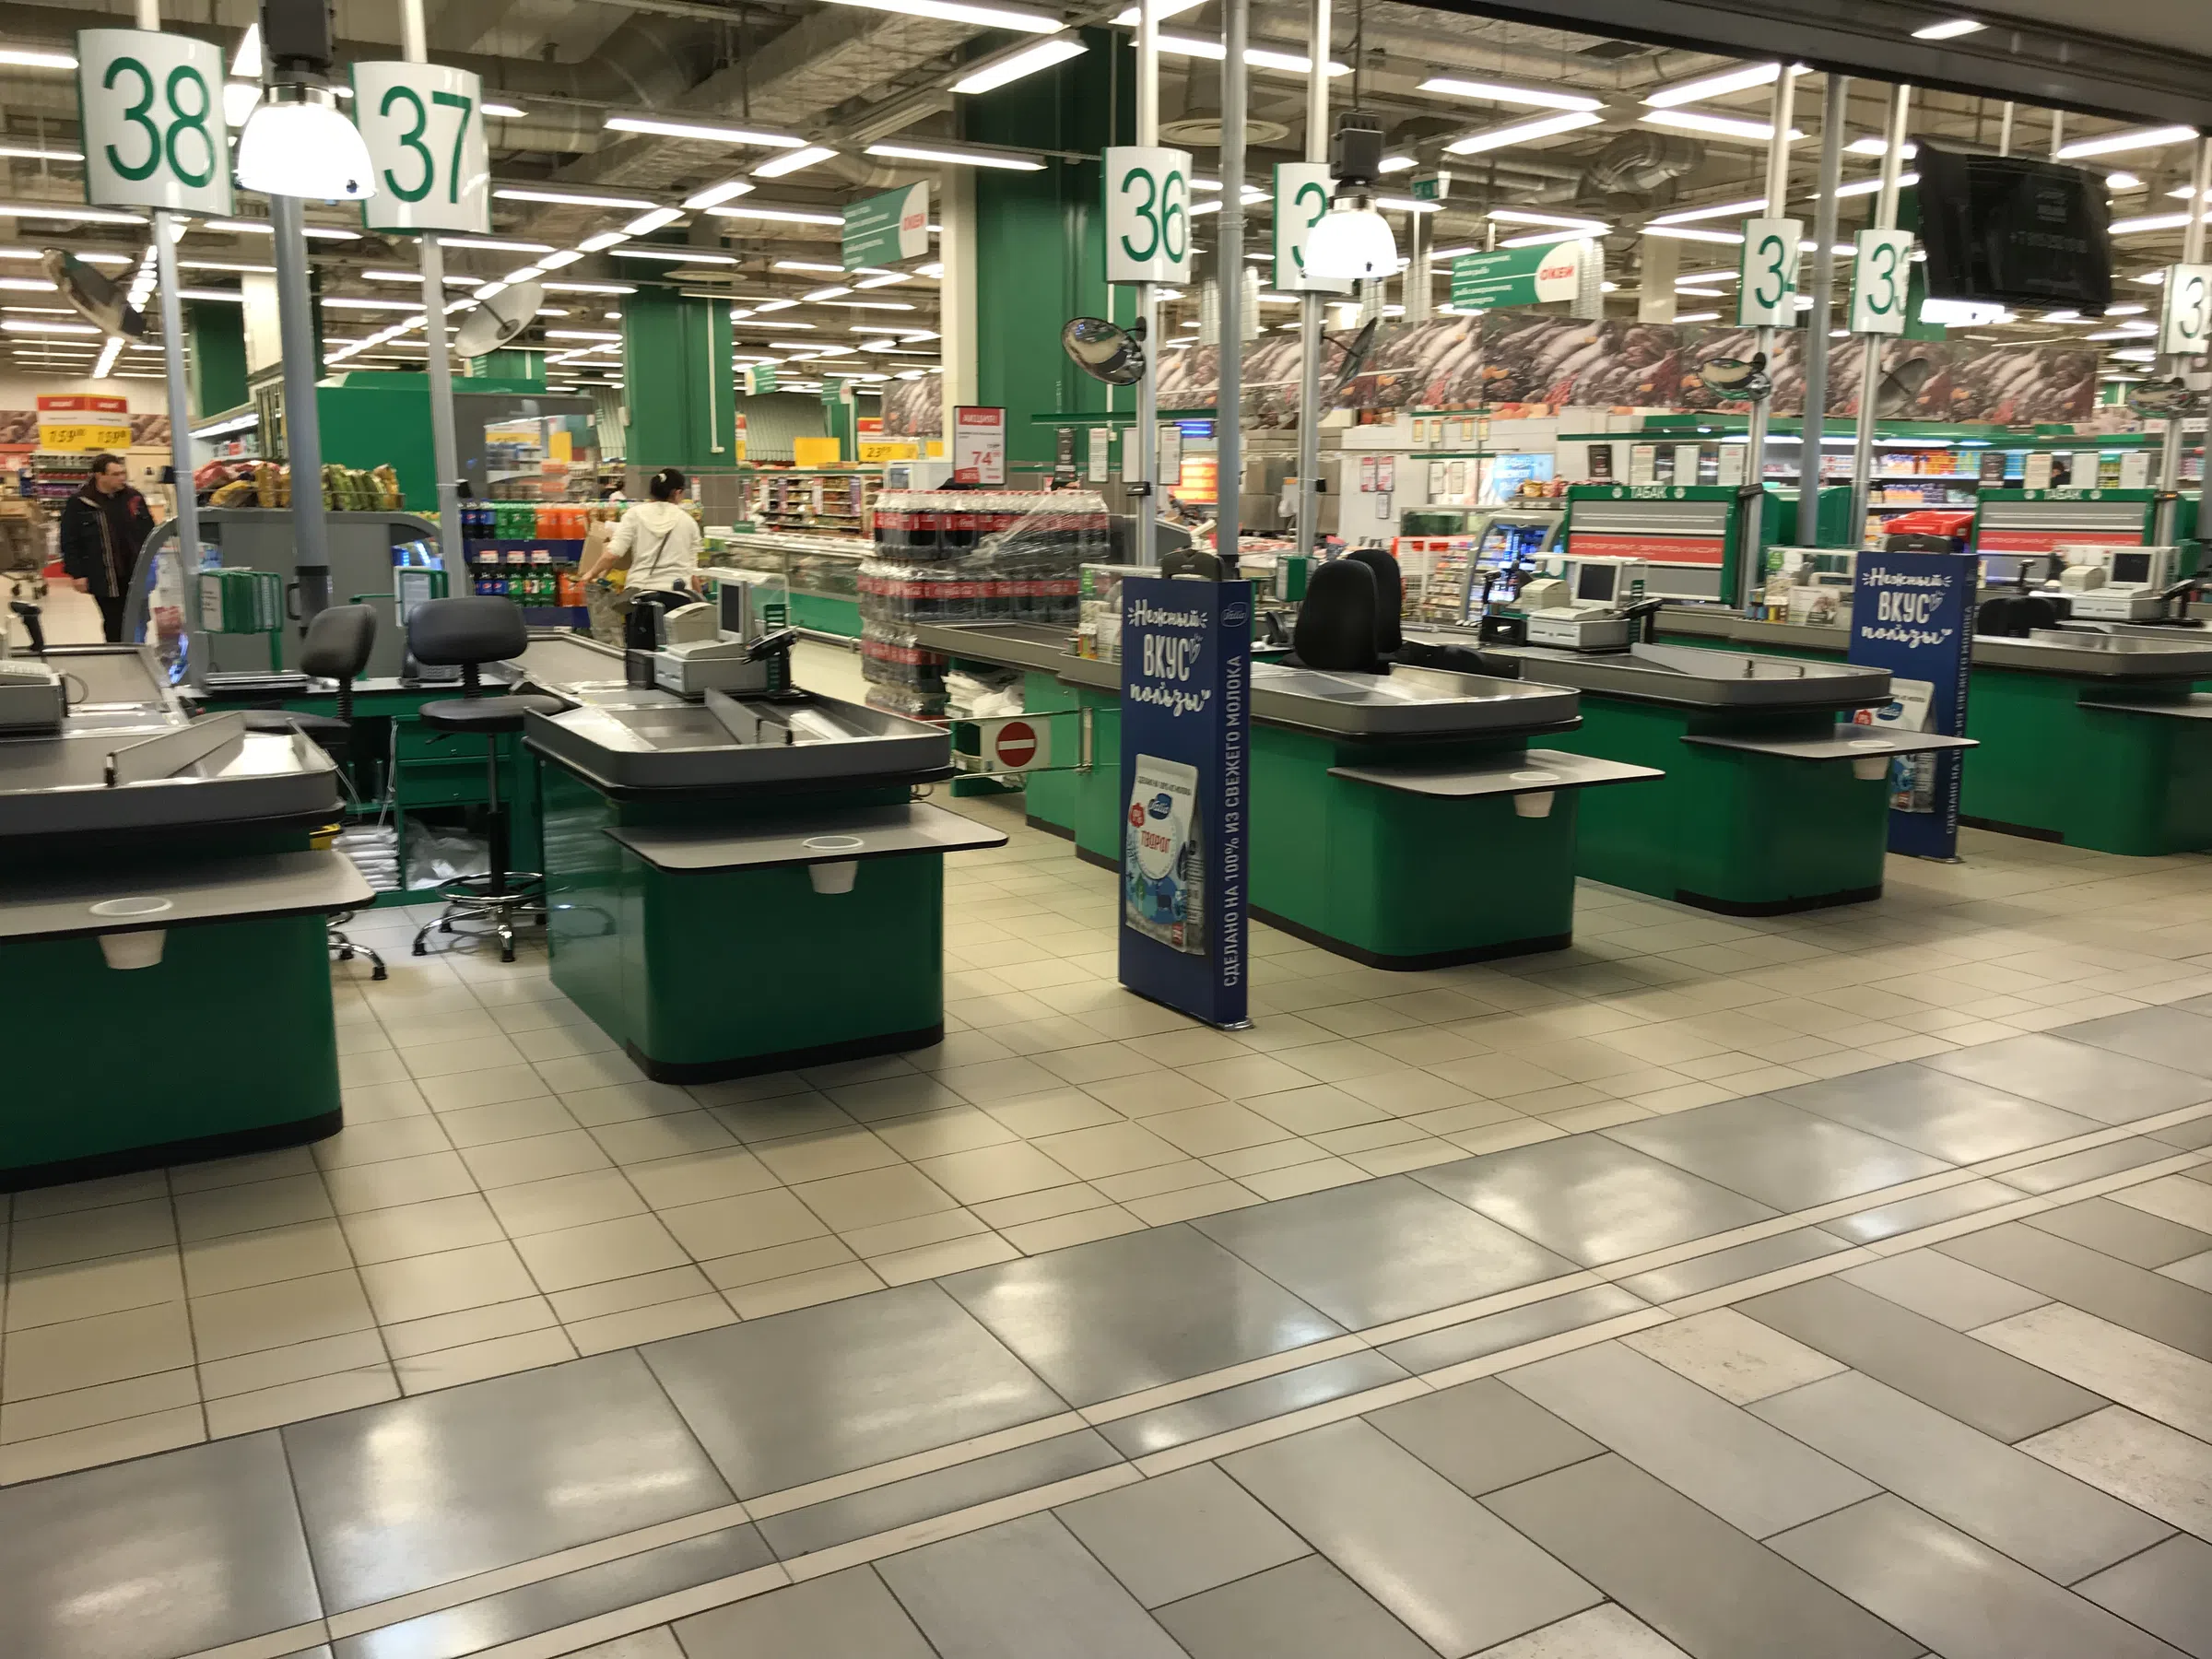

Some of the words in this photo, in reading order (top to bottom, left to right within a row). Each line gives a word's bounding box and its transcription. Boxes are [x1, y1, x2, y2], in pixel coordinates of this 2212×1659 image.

[102, 56, 216, 188] 38
[380, 86, 472, 204] 37
[1121, 168, 1186, 263] 36
[1291, 182, 1328, 268] 3
[1630, 487, 1668, 499] ТАБАК
[1869, 568, 1944, 587] Нежный
[1135, 599, 1200, 628] Нежный
[1877, 592, 1931, 624] ВКУС
[1144, 634, 1191, 681] ВКУС
[1226, 655, 1241, 726] МОЛОКА
[1225, 731, 1241, 807] СВЕЖЕГО
[1225, 812, 1240, 833] ИЗ
[1224, 837, 1240, 882] 100%
[1224, 885, 1239, 908] НА
[1224, 912, 1241, 987] СДЕЛАНО
